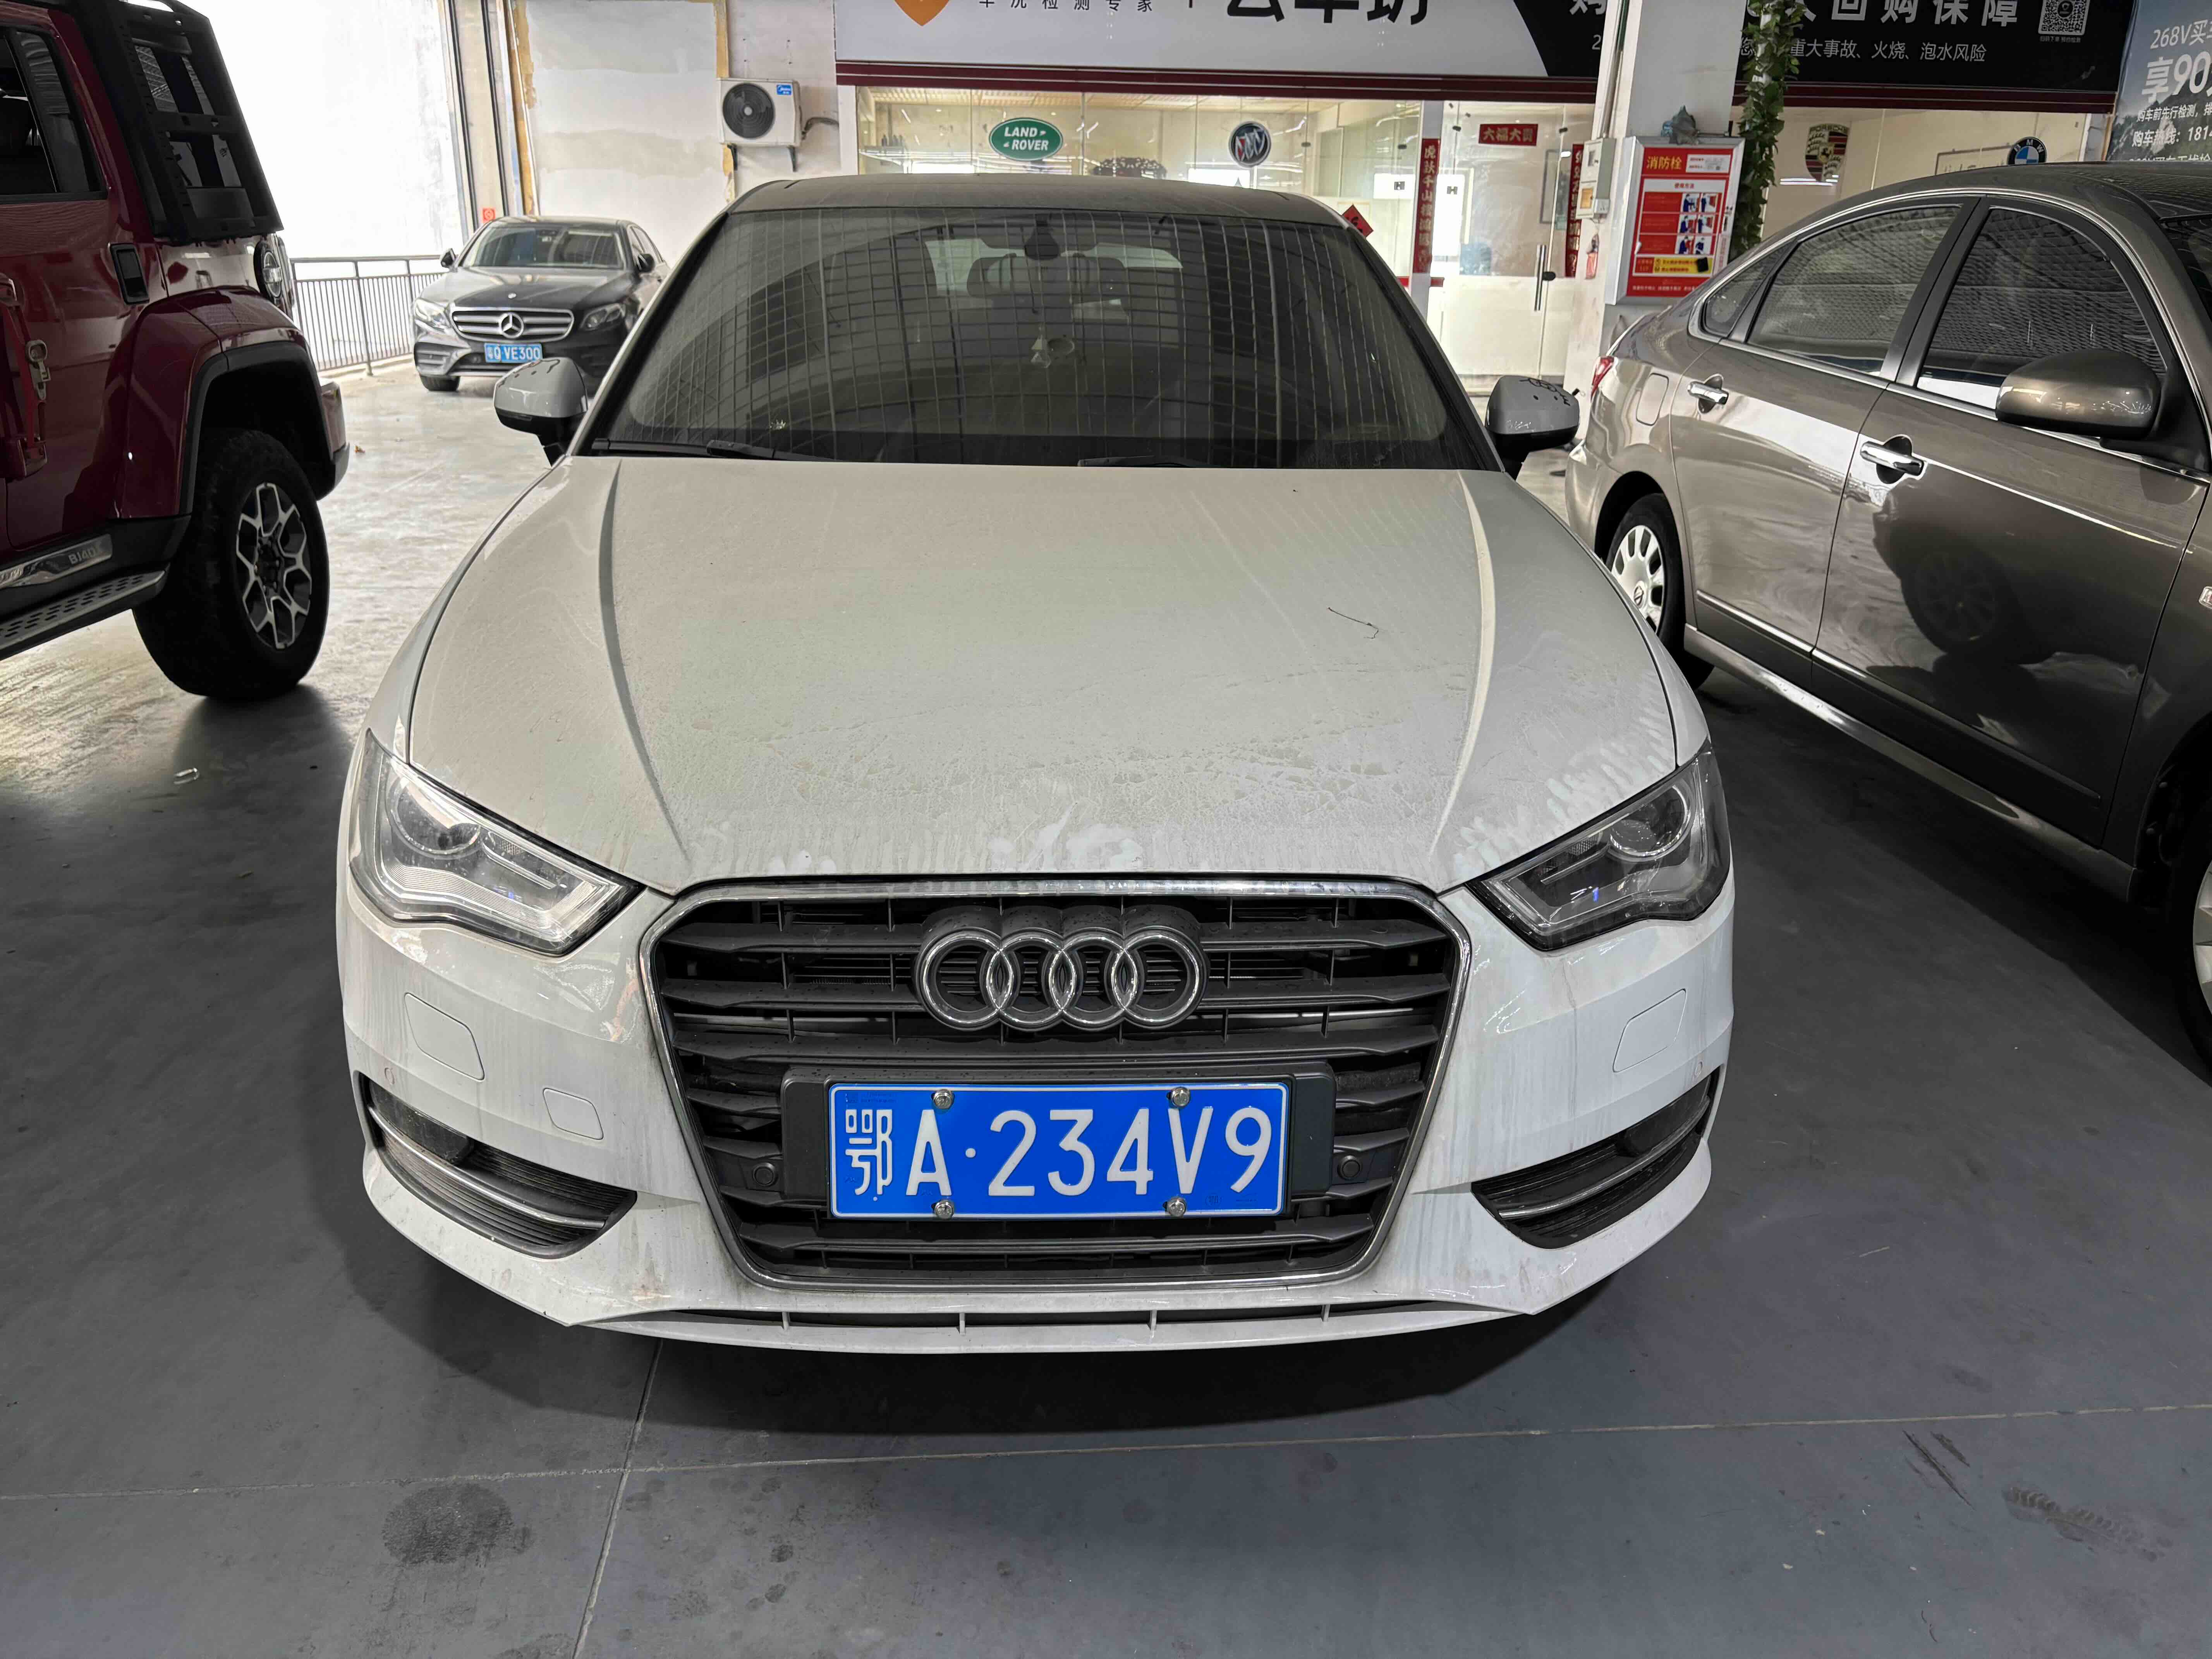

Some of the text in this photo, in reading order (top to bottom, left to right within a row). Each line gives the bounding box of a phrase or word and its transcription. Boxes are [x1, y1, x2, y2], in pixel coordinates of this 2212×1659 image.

[2142, 51, 2212, 103] 享90
[1004, 127, 1038, 137] LAND
[1012, 139, 1049, 151] ROVER
[2014, 139, 2044, 153] BMW
[1647, 156, 1682, 170] 消防栓
